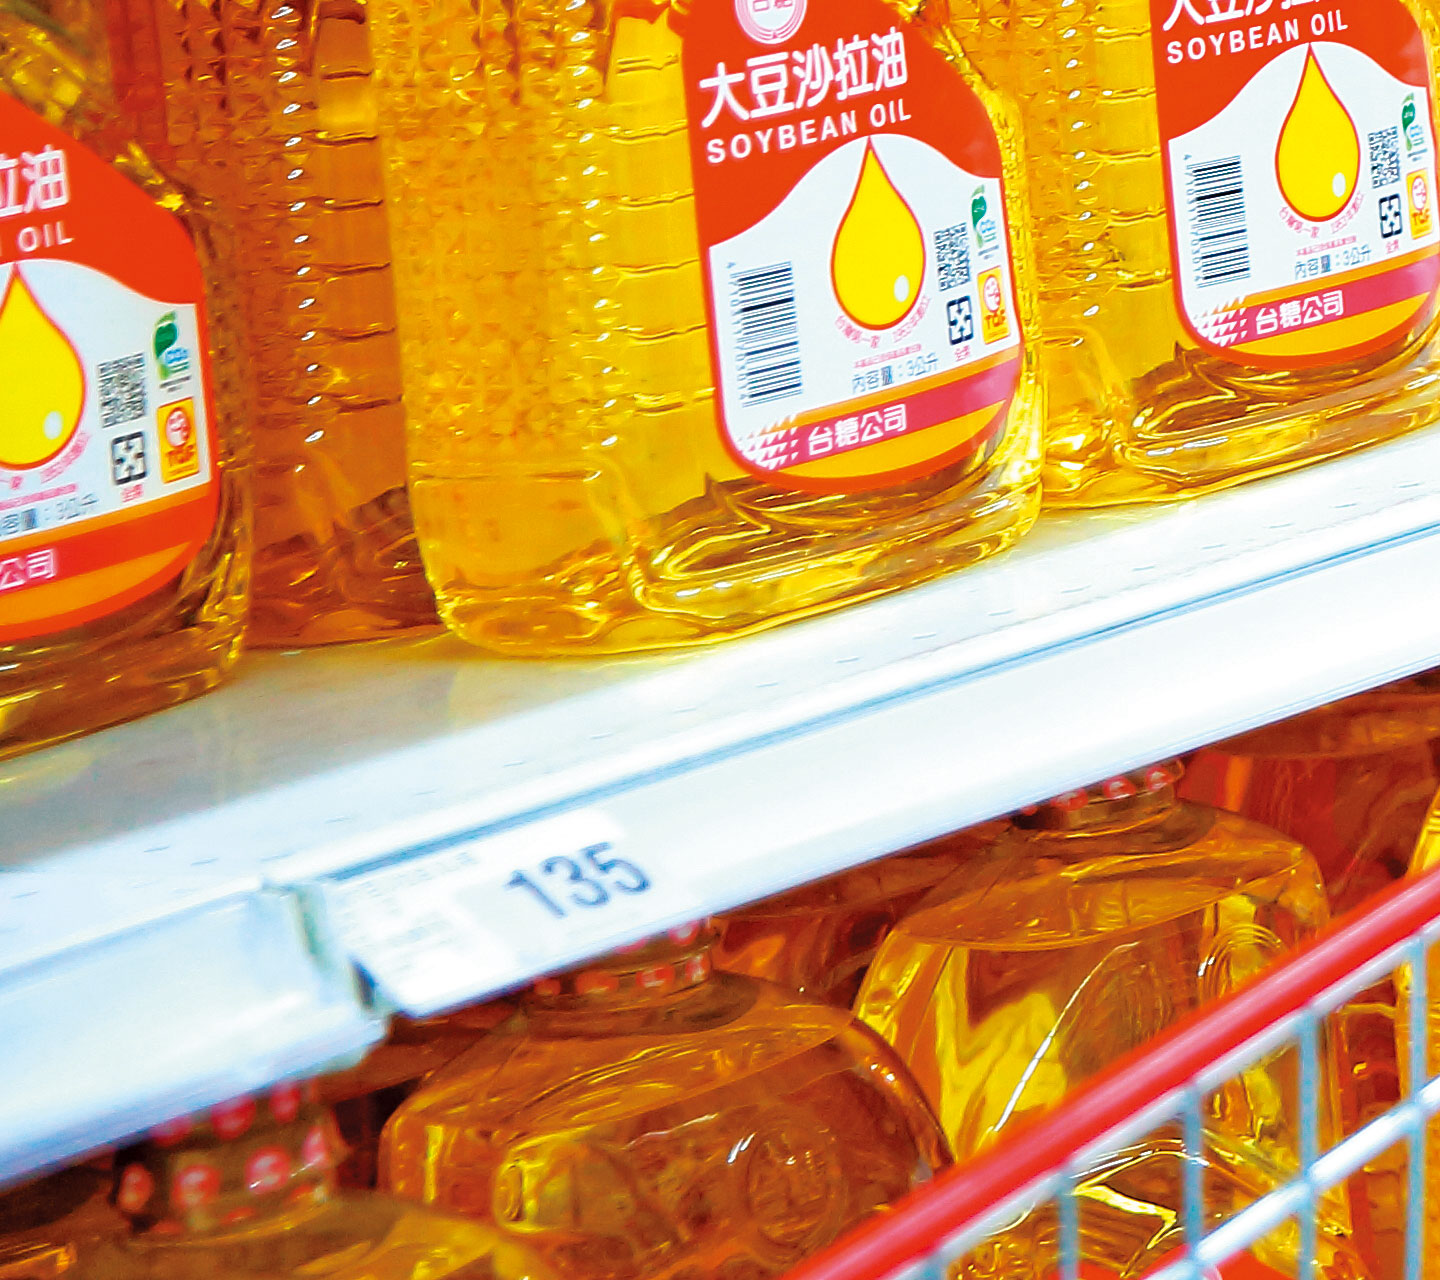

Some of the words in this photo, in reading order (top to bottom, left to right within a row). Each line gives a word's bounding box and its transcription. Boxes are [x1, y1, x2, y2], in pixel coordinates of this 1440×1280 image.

[1166, 23, 1300, 65] SOYBEAN
[1310, 7, 1349, 36] OIL
[698, 24, 908, 129] 大豆沙拉油
[705, 110, 857, 165] SOYBEAN
[869, 97, 912, 126] OIL
[18, 223, 74, 252] OIL
[1255, 288, 1345, 337] 台糖公司
[806, 403, 909, 458] 台糖公司
[504, 842, 653, 918] 135
